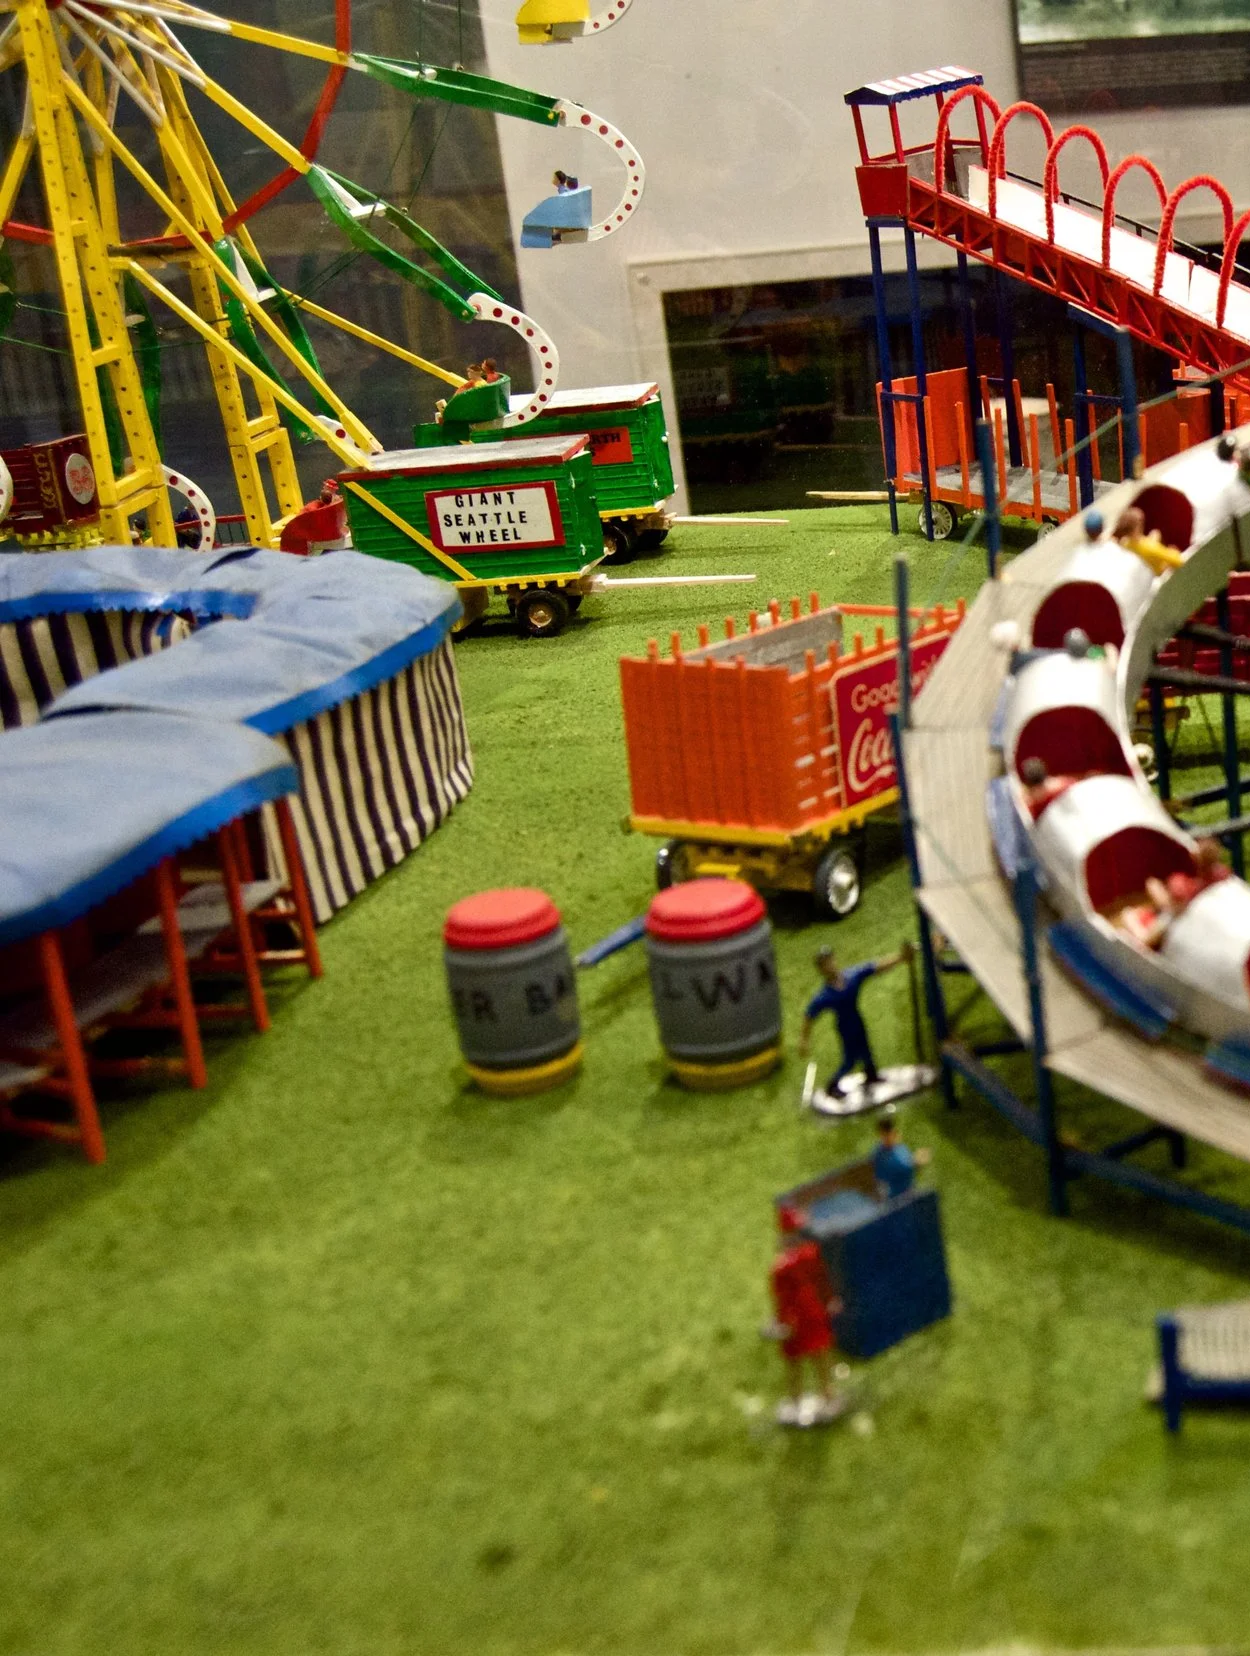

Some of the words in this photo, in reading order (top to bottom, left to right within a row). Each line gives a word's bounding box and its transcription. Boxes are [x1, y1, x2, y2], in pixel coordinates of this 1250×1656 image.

[455, 491, 515, 508] GIANT
[443, 511, 527, 527] SEATTLE
[459, 528, 521, 544] WHEEL
